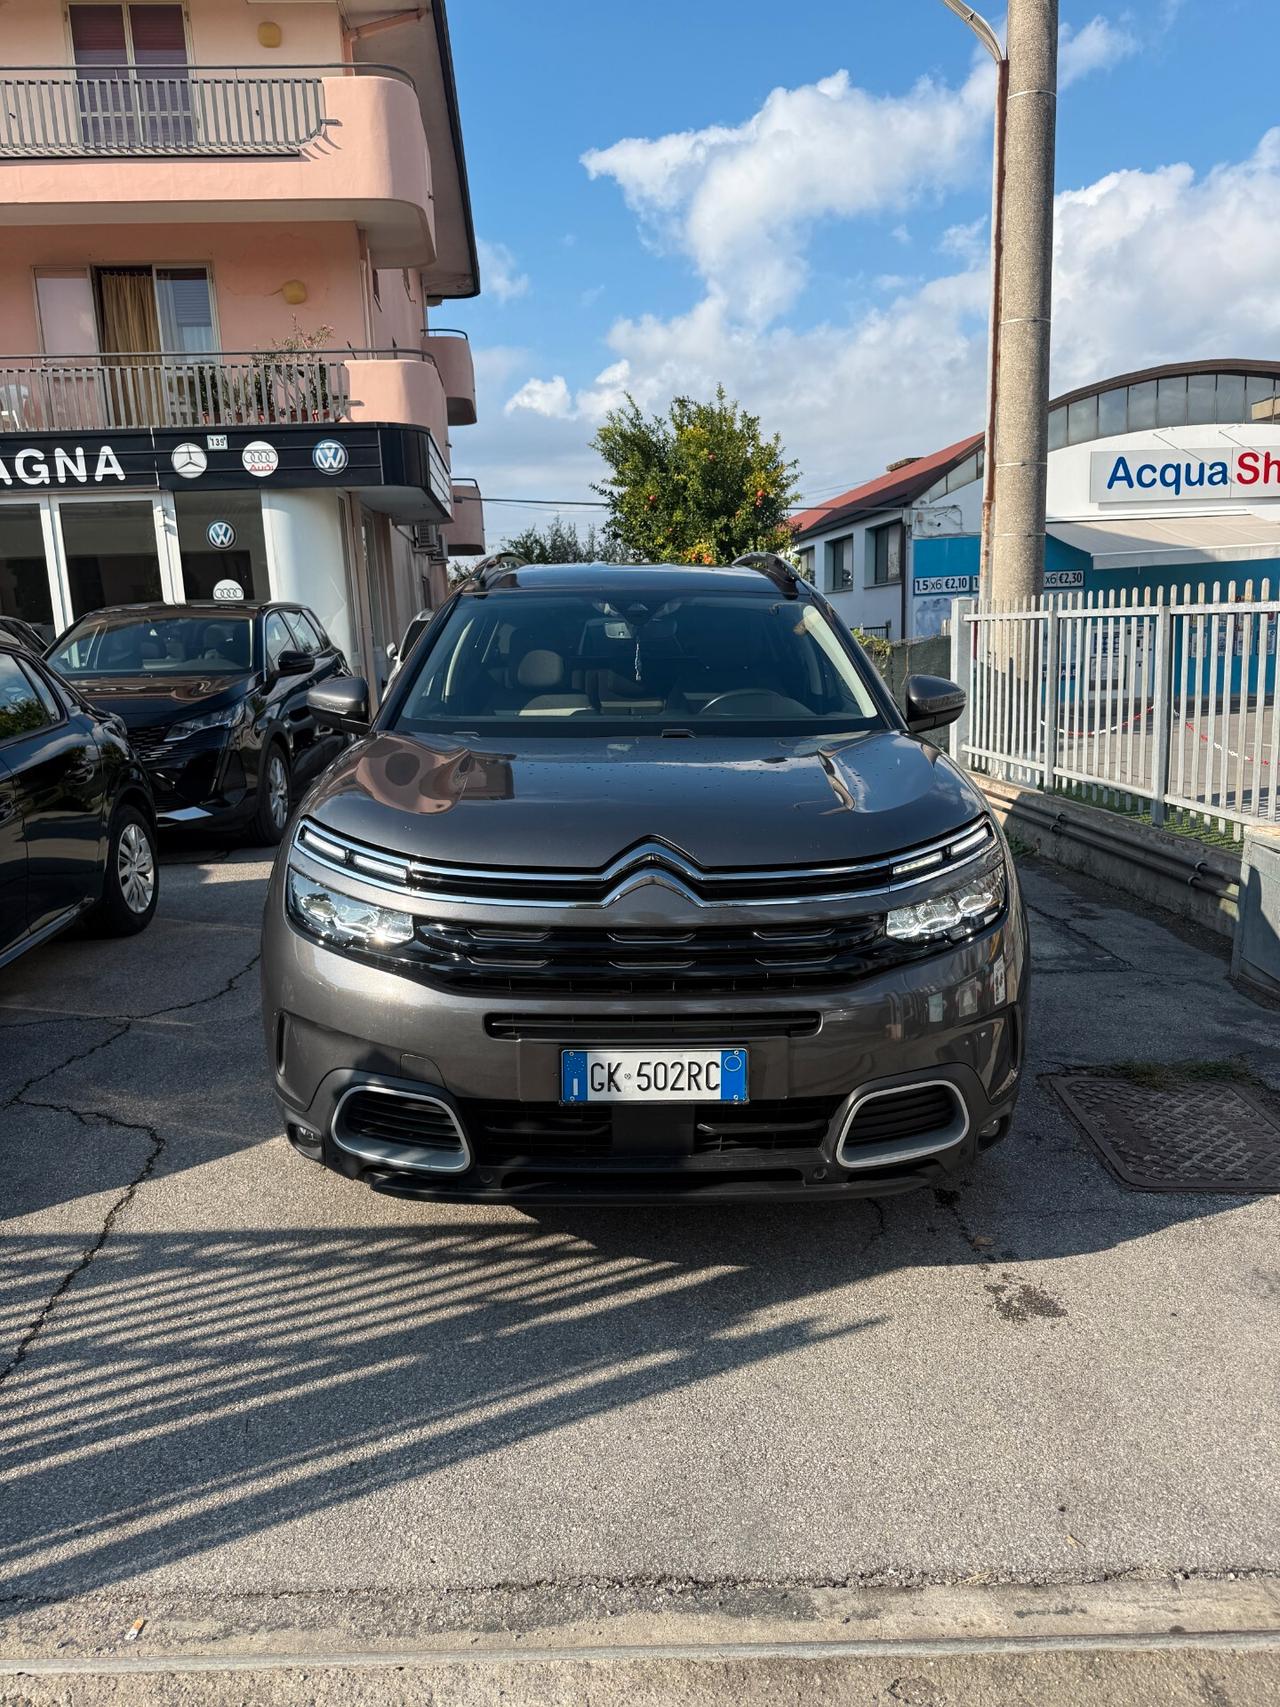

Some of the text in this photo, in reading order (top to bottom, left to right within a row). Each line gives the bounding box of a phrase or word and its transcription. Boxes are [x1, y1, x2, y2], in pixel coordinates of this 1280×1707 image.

[211, 438, 225, 447] 139
[931, 579, 943, 590] x6
[590, 1062, 622, 1092] GK
[636, 1061, 721, 1091] 502RC
